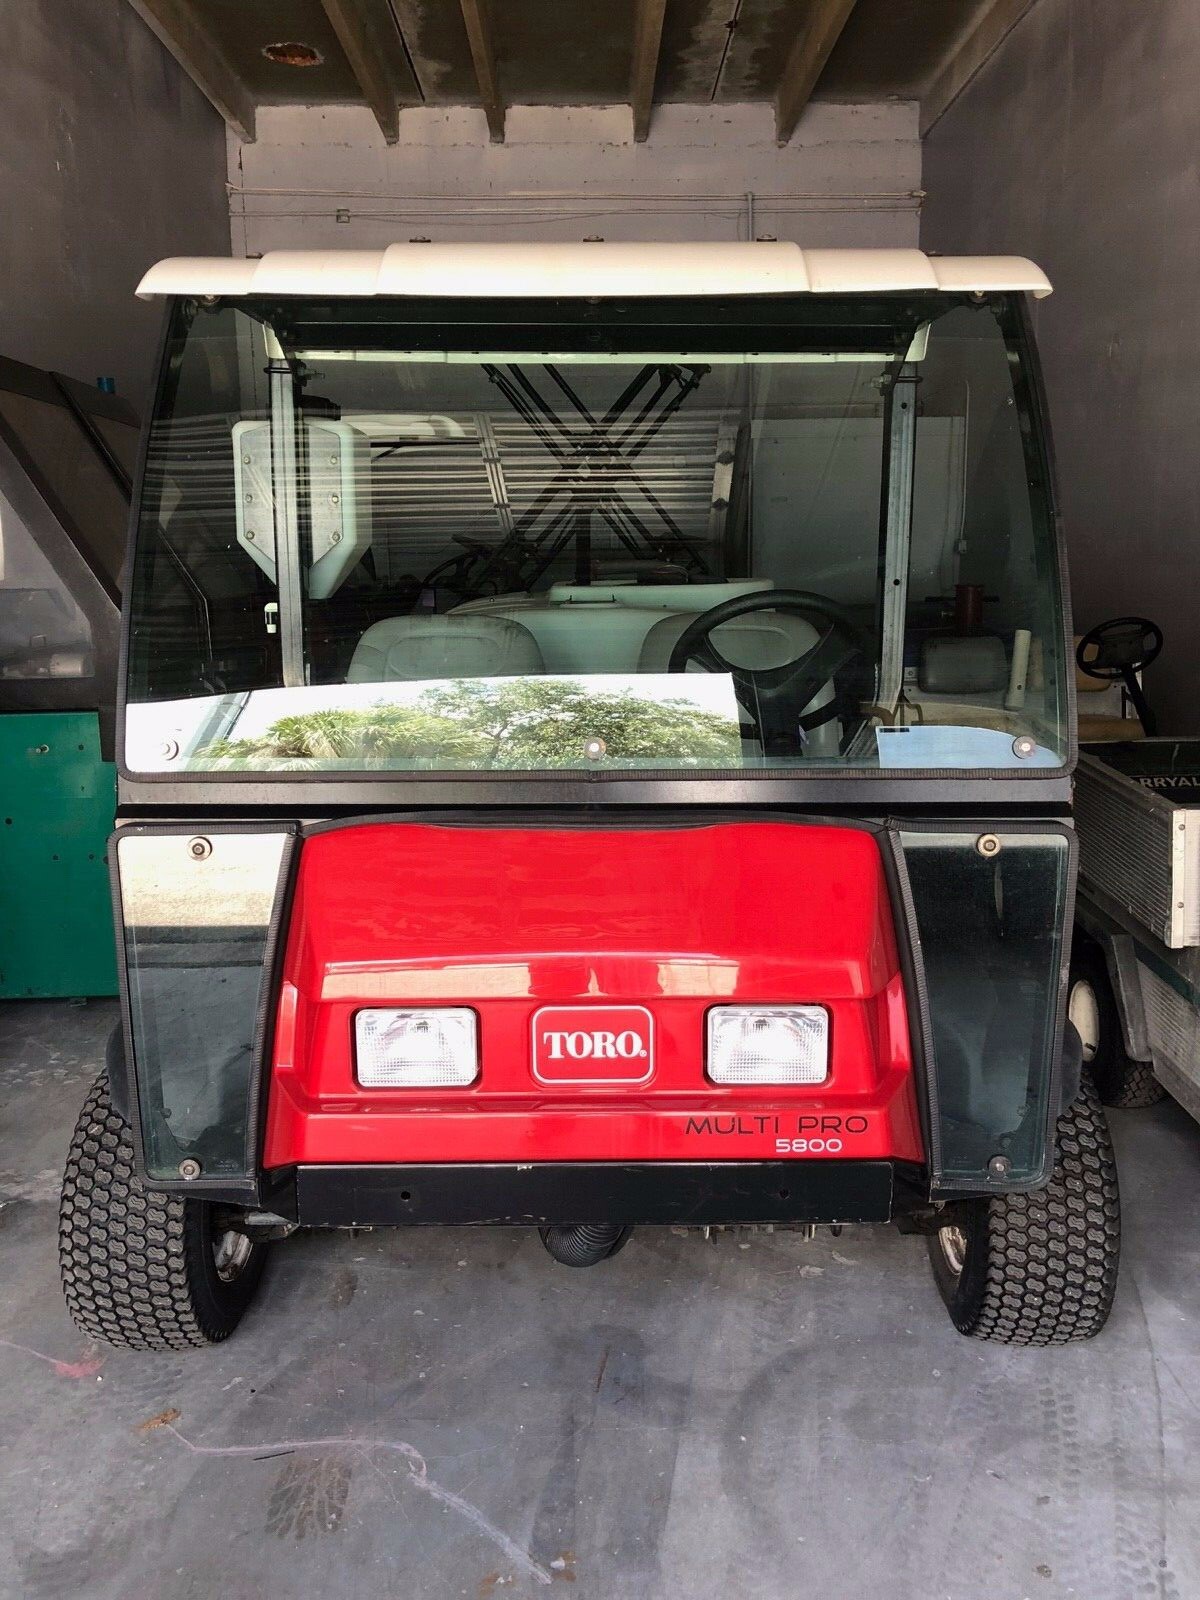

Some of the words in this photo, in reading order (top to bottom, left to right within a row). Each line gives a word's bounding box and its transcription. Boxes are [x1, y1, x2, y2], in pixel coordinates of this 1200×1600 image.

[543, 1030, 643, 1059] TORO
[685, 1116, 779, 1135] MULTI
[798, 1115, 868, 1134] PRO
[775, 1138, 843, 1153] 5800
